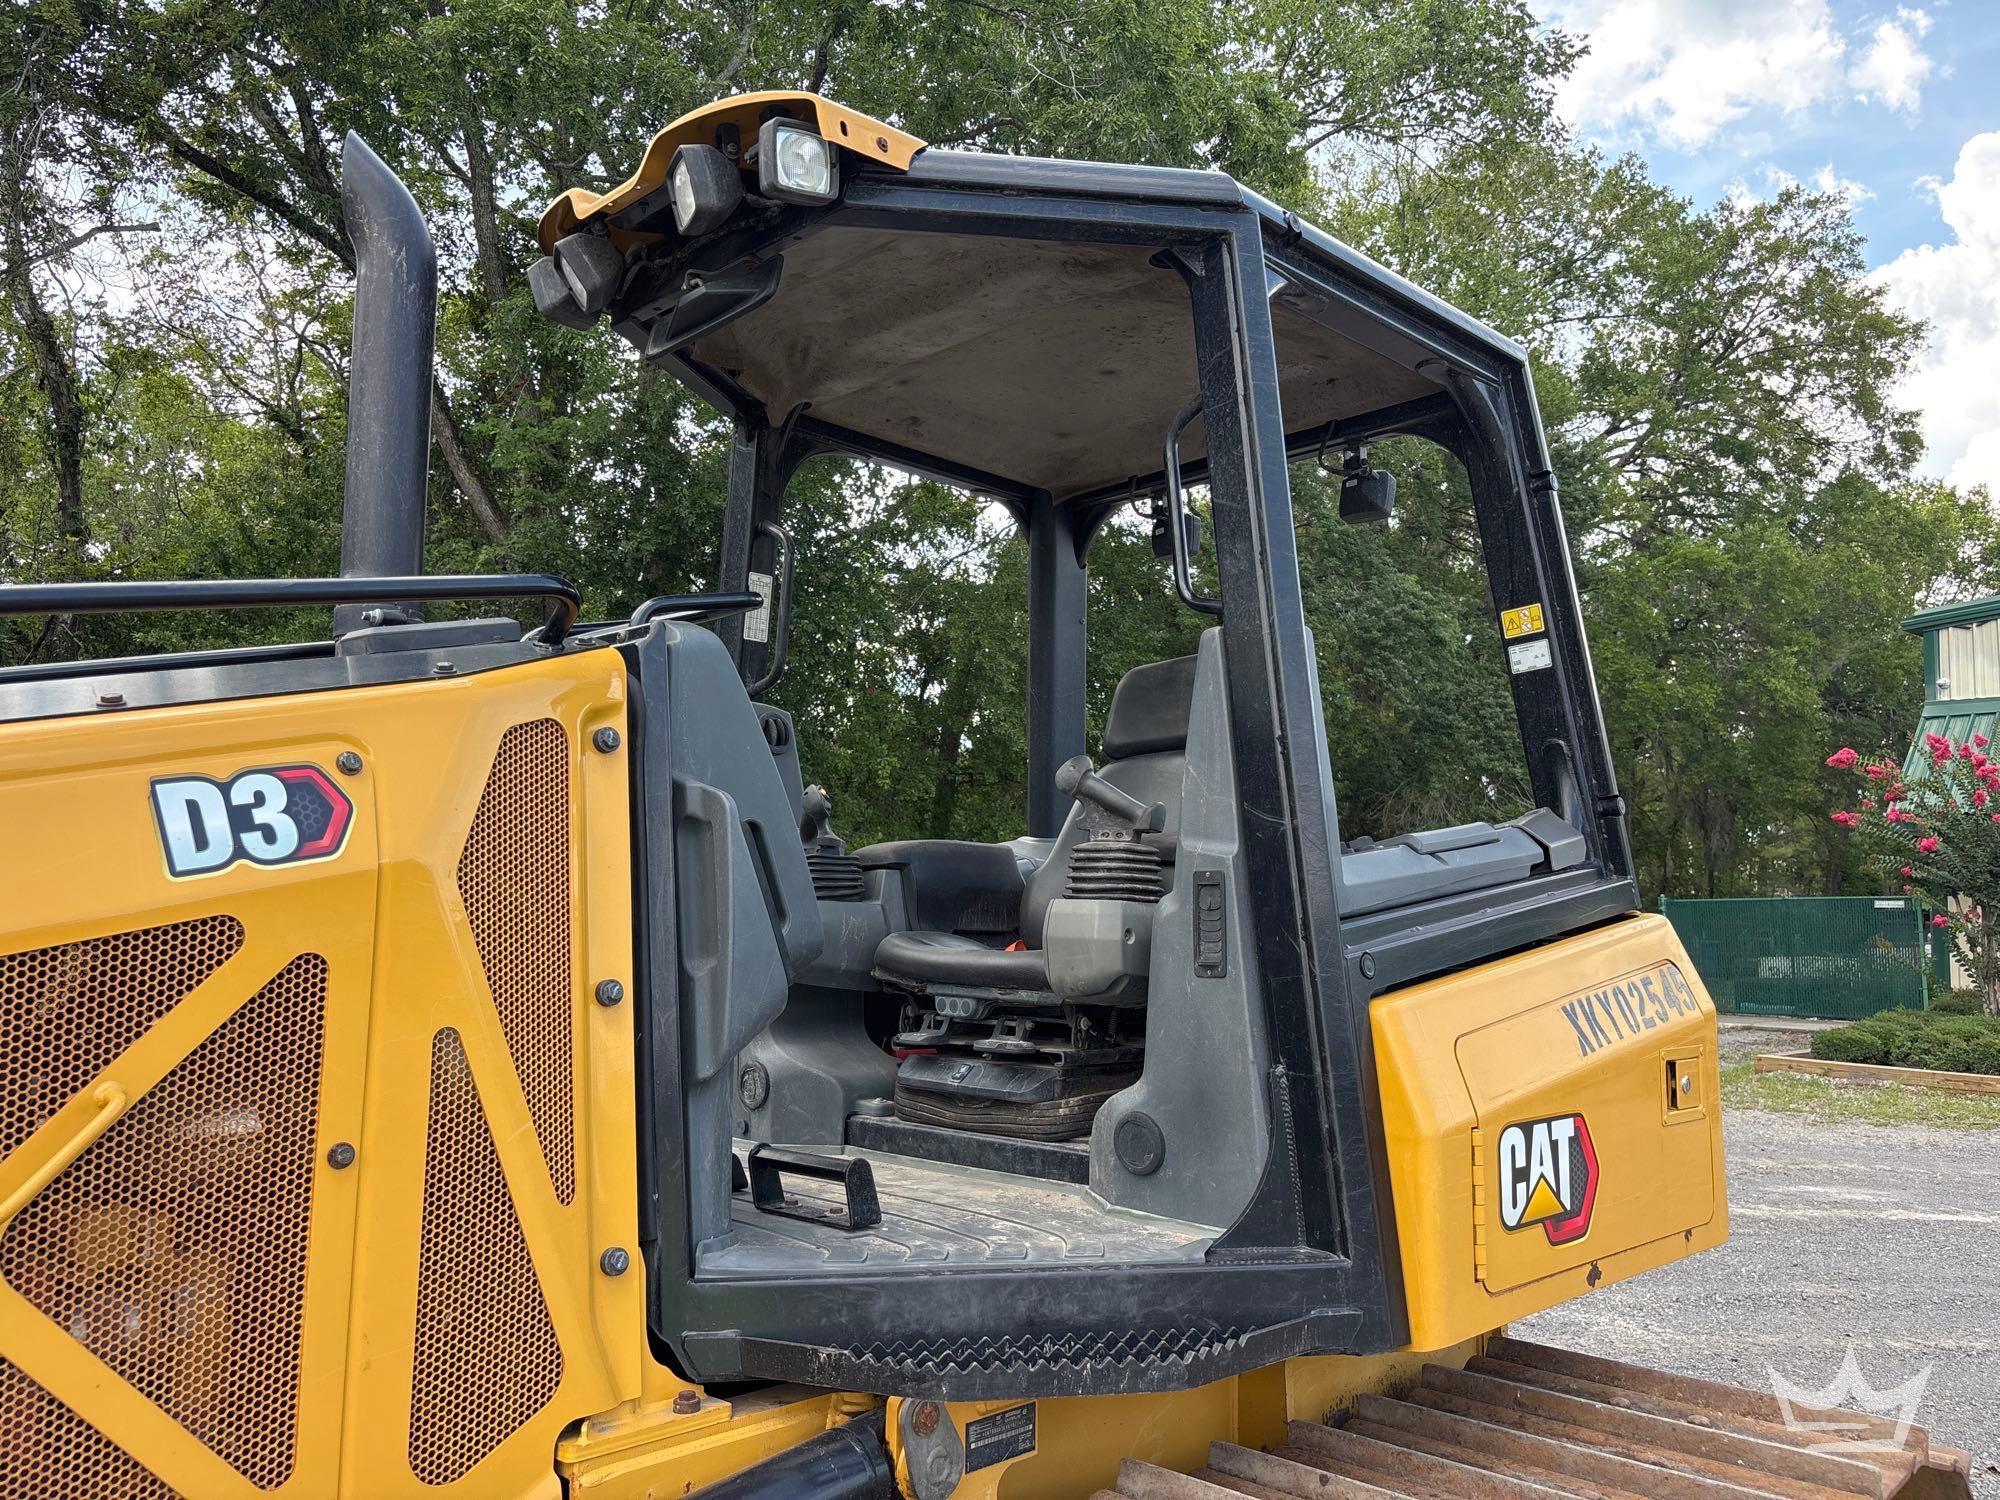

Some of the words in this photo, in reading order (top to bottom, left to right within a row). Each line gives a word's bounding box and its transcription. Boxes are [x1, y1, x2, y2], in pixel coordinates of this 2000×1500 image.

[155, 773, 299, 873] D3
[1560, 964, 1697, 1058] XKY02545
[1500, 1117, 1575, 1227] CAT
